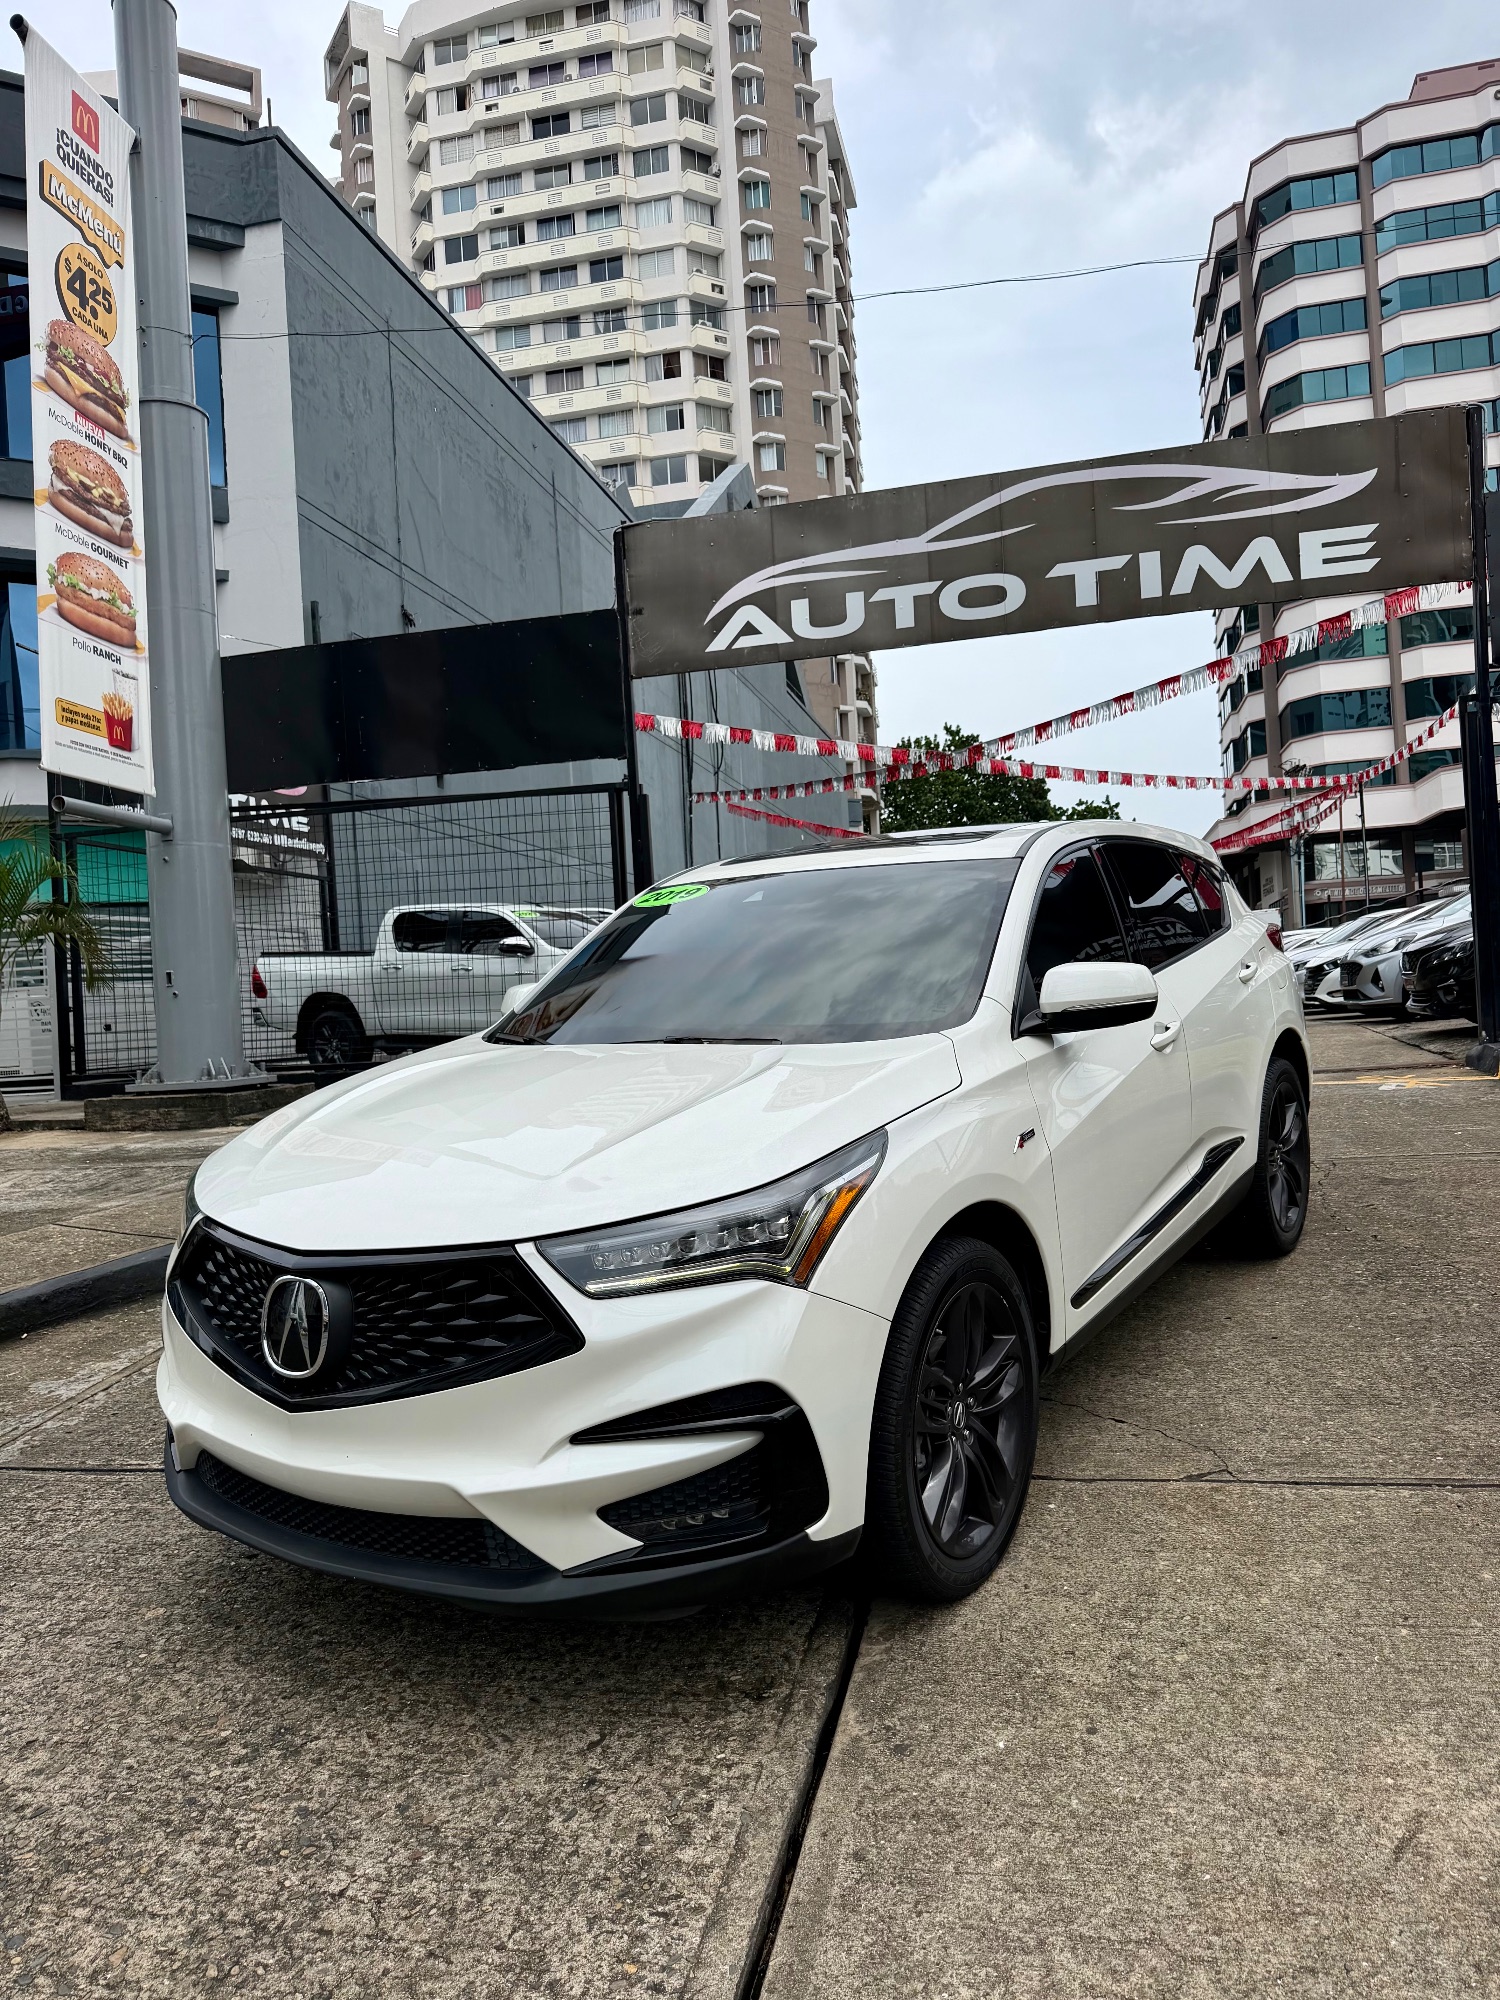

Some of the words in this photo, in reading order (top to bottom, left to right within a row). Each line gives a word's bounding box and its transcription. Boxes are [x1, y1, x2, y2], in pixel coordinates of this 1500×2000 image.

[56, 127, 114, 190] ¡CUANDO
[56, 143, 114, 208] QUIERAS!
[48, 173, 122, 258] McMenú
[77, 252, 83, 263] A
[82, 257, 104, 279] SOLO
[72, 306, 93, 329] CADA
[93, 322, 109, 341] UNA
[48, 407, 84, 438] McDoble
[84, 430, 112, 456] HONEY
[112, 448, 128, 469] BBQ
[75, 413, 105, 440] NUEVA
[55, 522, 90, 549] McDoble
[90, 542, 130, 570] GOURMET
[705, 572, 1026, 652] AUTO
[1044, 523, 1381, 608] TIME
[72, 636, 92, 653] Pollo
[93, 645, 122, 665] RANCH
[637, 887, 703, 905] 2019
